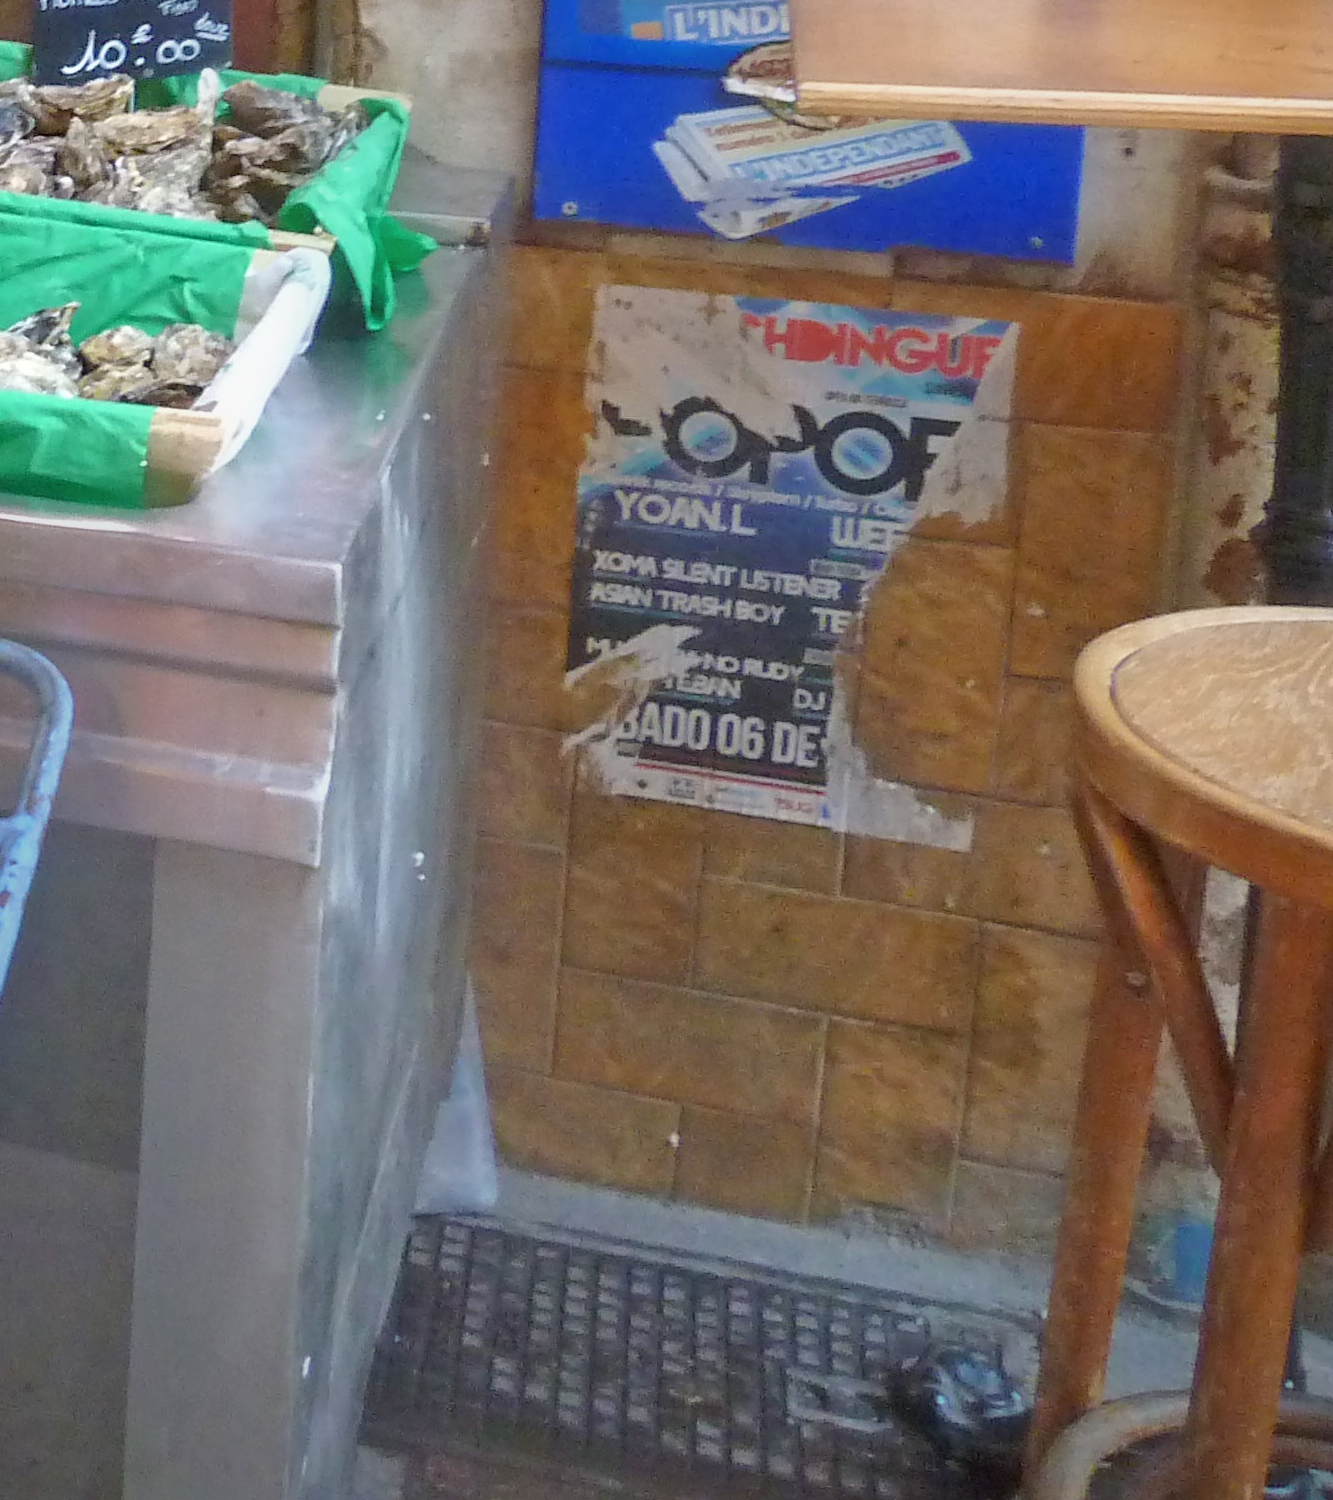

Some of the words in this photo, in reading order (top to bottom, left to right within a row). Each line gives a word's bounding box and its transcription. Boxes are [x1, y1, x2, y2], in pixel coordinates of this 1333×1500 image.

[593, 549, 658, 578] XOMA
[662, 557, 738, 588] SILENT
[739, 565, 843, 601] LISTENER
[589, 581, 654, 608] ASIAN
[657, 588, 732, 619] TRASH
[734, 601, 787, 626] BOY
[662, 672, 742, 700] TEBAN
[615, 700, 711, 752] BADO
[715, 712, 765, 760] 06
[771, 720, 830, 769] DE
